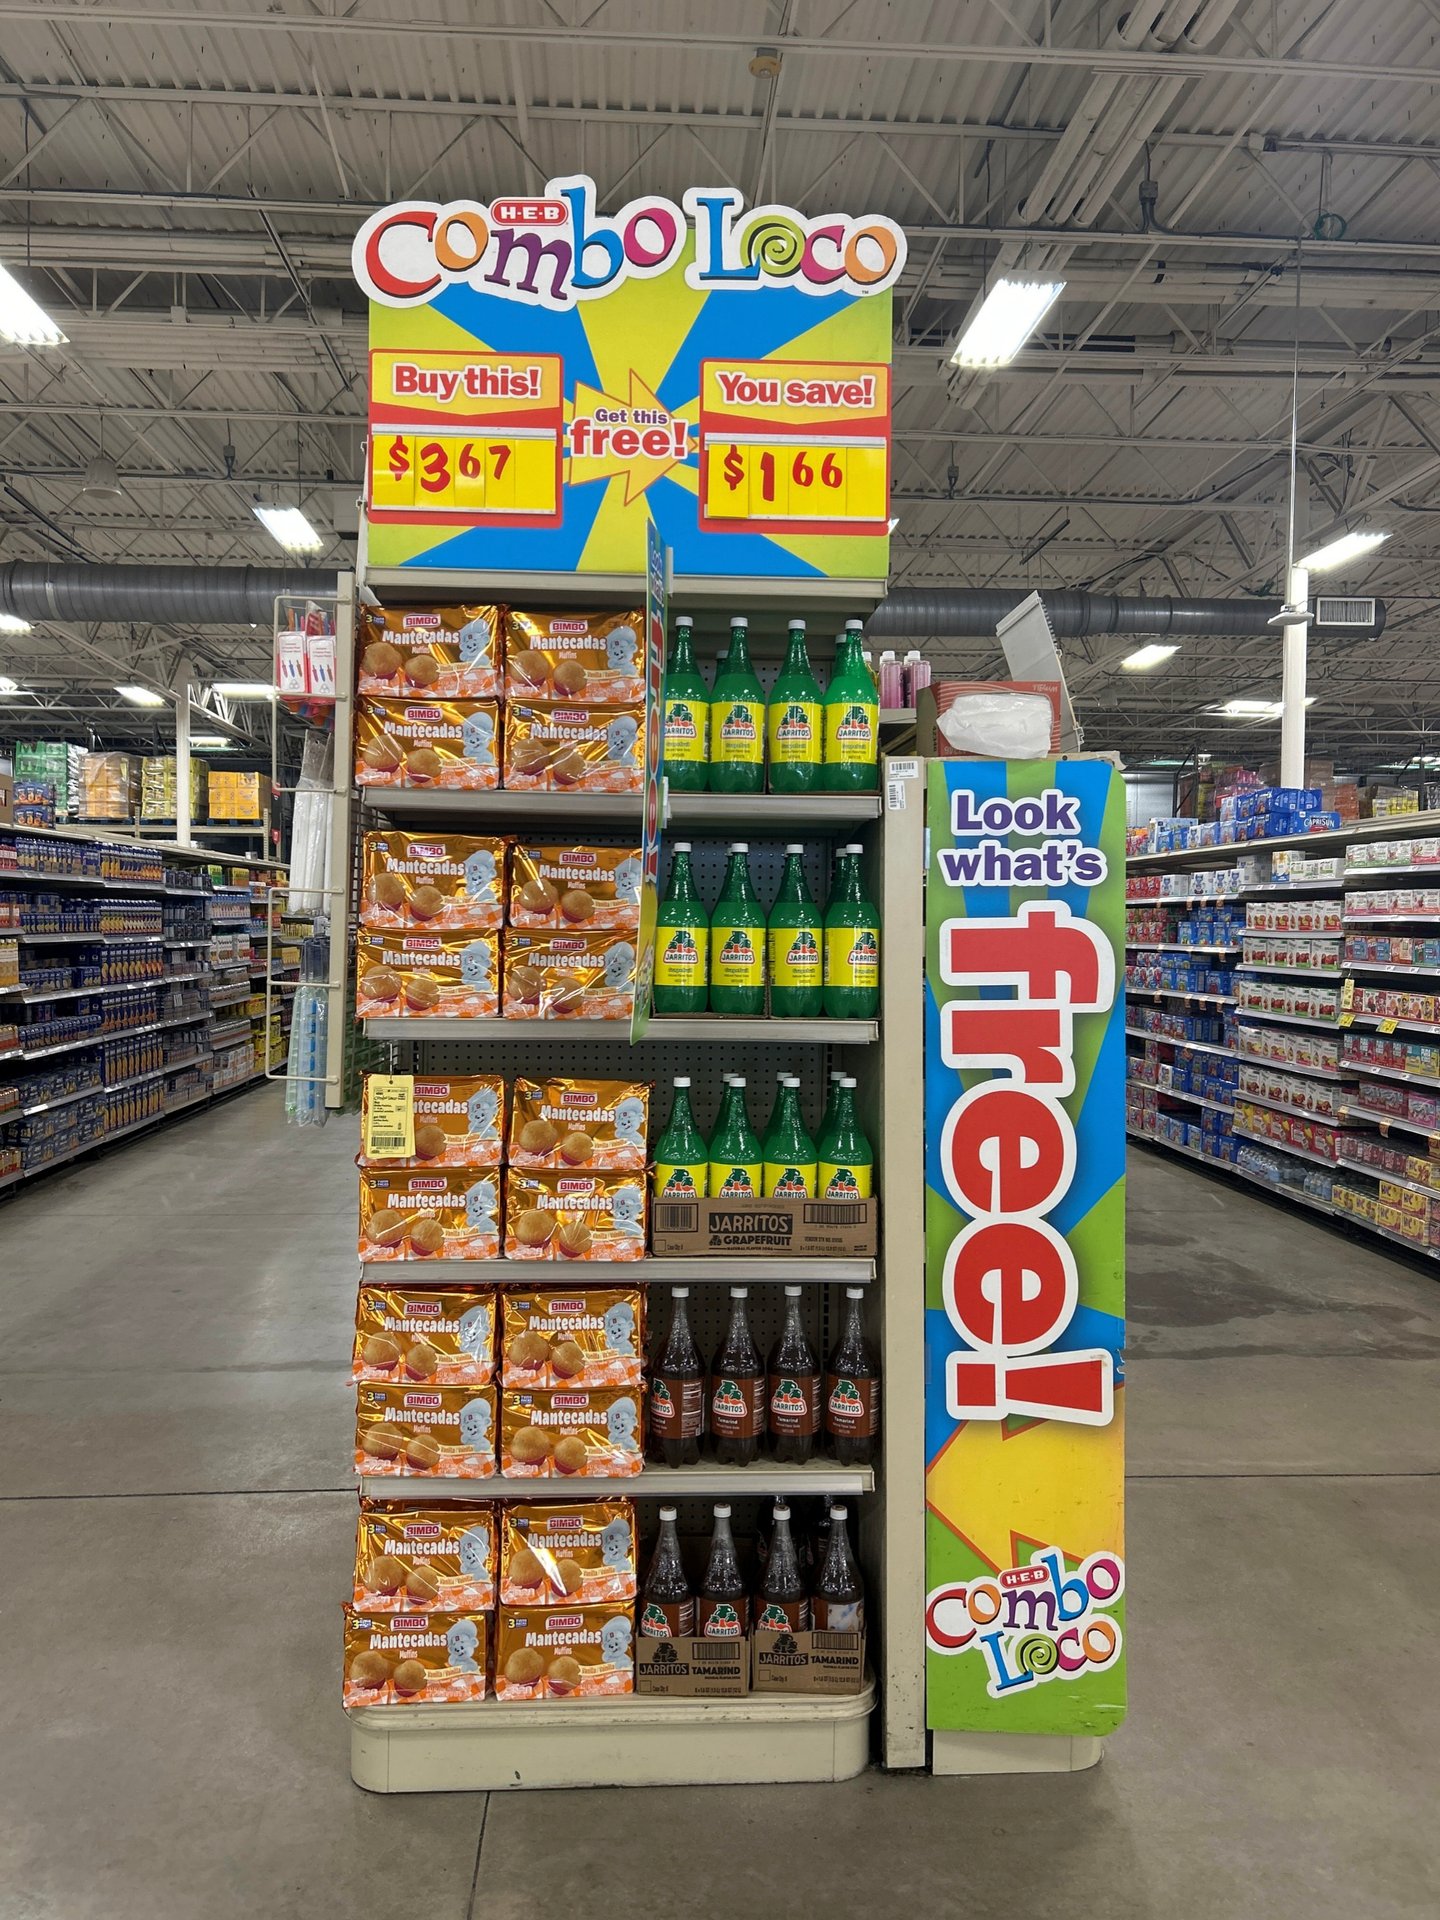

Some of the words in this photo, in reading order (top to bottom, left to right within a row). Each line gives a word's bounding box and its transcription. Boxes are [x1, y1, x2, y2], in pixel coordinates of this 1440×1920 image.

[366, 186, 678, 300] Combo
[696, 197, 899, 285] Loco
[394, 365, 455, 400] Buy
[464, 367, 540, 397] this!
[718, 374, 780, 403] You
[786, 378, 873, 405] save!
[595, 408, 629, 424] Get
[633, 408, 668, 425] this
[570, 419, 688, 459] free!
[406, 617, 439, 626] BIMBO
[552, 622, 586, 631] BIMBO
[383, 630, 460, 645] Mantecadas
[530, 635, 607, 650] Mantecadas
[407, 709, 441, 719] BIMBO
[384, 722, 463, 738] Mantecadas
[531, 723, 608, 741] Mantecadas
[957, 794, 1080, 832] Look
[562, 854, 594, 863] BIMBO
[943, 843, 1104, 883] what's
[387, 858, 465, 875] Mantecadas
[540, 865, 615, 882] Mantecadas
[383, 951, 462, 966] Mantecadas
[529, 952, 605, 968] Mantecadas
[415, 1086, 447, 1095] BIMBO
[563, 1094, 595, 1104] BIMBO
[541, 1105, 616, 1122] Mantecadas
[950, 909, 1104, 1415] free!
[411, 1179, 445, 1189] BIMBO
[560, 1180, 593, 1190] BIMBO
[387, 1193, 466, 1209] Mantecadas
[537, 1194, 613, 1210] Mantecadas
[664, 1191, 695, 1199] JARRITOS
[721, 1191, 752, 1199] JARRITOS
[775, 1191, 806, 1199] JARRITOS
[827, 1191, 858, 1199] JARRITOS
[709, 1214, 789, 1233] JARRITOS
[724, 1235, 792, 1246] GRAPEFRUIT
[406, 1304, 439, 1312] BIMBO
[552, 1302, 584, 1310] BIMBO
[384, 1316, 460, 1333] Mantecadas
[529, 1314, 605, 1331] Mantecadas
[406, 1396, 439, 1404] BIMBO
[554, 1396, 587, 1404] BIMBO
[714, 1402, 743, 1412] JARRITOS
[774, 1402, 803, 1411] JARRITOS
[831, 1403, 860, 1413] JARRITOS
[384, 1407, 460, 1425] Mantecadas
[530, 1409, 608, 1425] Mantecadas
[384, 1539, 460, 1555] Mantecadas
[527, 1531, 602, 1548] Mantecadas
[926, 1553, 1121, 1649] Combo
[393, 1619, 426, 1628] BIMBO
[548, 1617, 581, 1627] BIMBO
[708, 1626, 738, 1634] JARRITOS
[370, 1631, 447, 1649] Mantecadas
[525, 1629, 602, 1647] Mantecadas
[760, 1654, 807, 1665] JARRITOS
[811, 1656, 859, 1664] TAMARIND
[979, 1620, 1117, 1691] Loco
[640, 1664, 687, 1675] JARRITOS
[692, 1667, 740, 1675] TAMARIND
